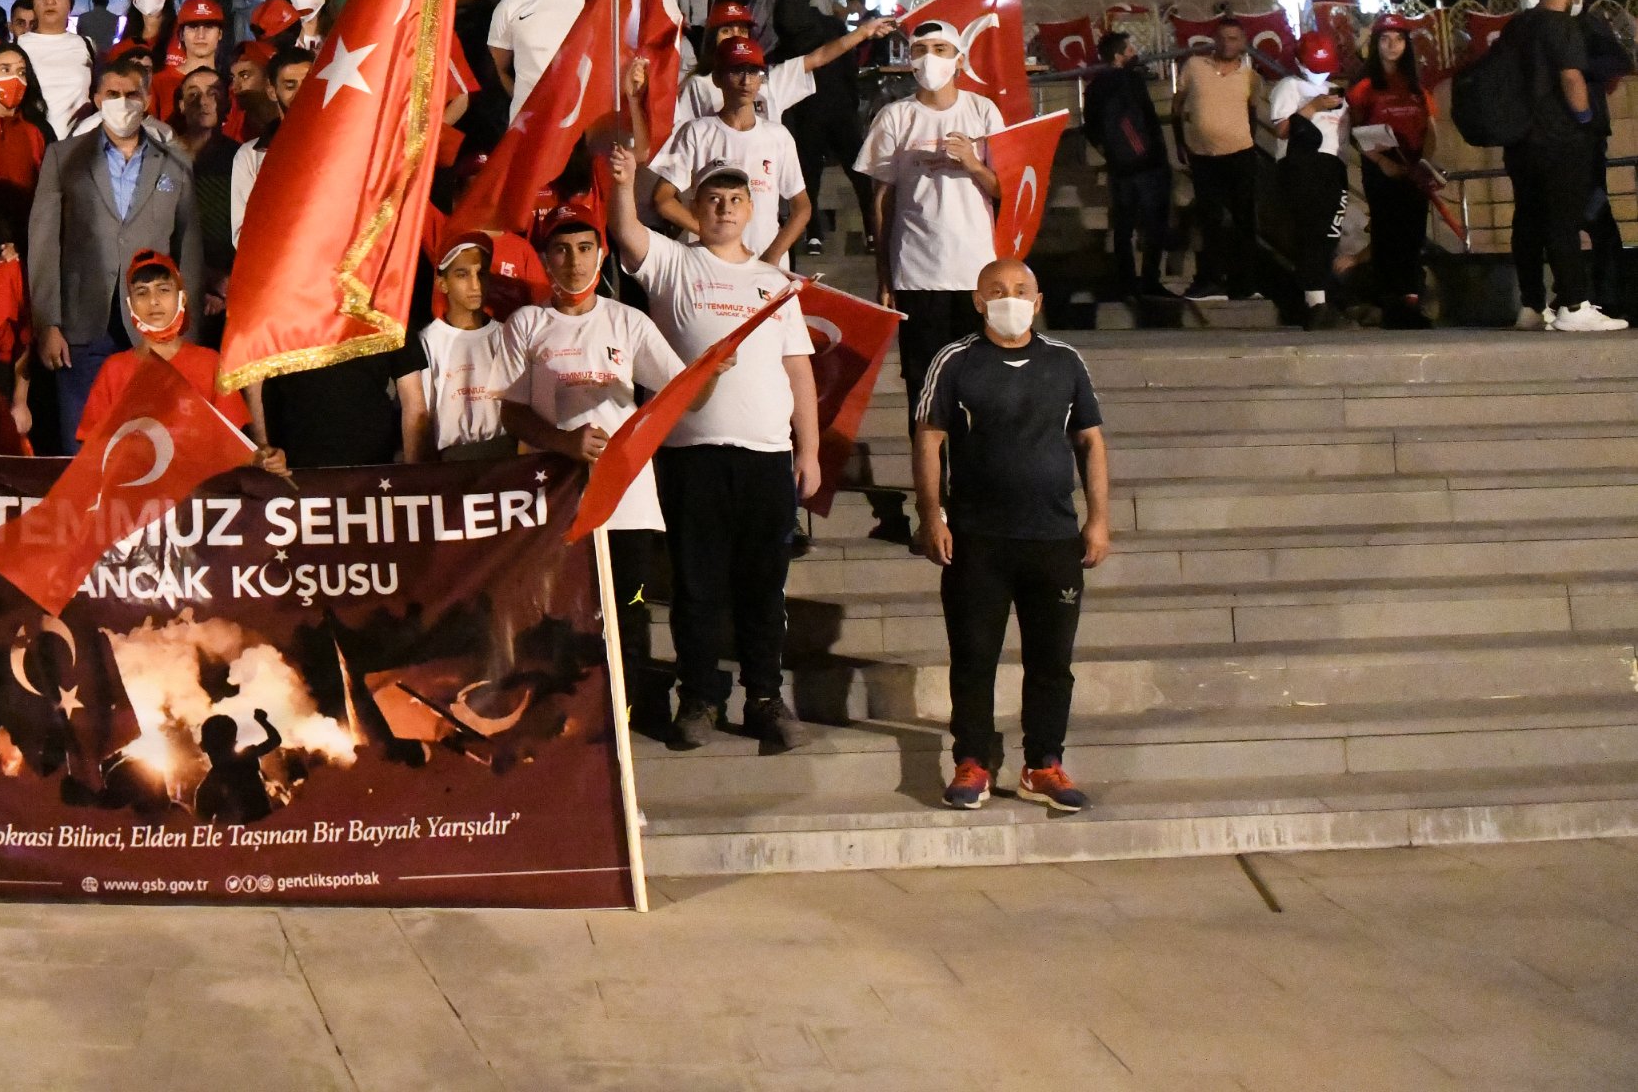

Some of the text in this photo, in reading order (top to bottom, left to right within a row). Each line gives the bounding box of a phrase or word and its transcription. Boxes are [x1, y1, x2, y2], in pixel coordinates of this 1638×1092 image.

[707, 303, 744, 312] TEMMUZ
[558, 371, 593, 381] TEMMUZ
[231, 561, 400, 607] KOŞUSU
[57, 824, 126, 852] Bilinci,
[130, 824, 187, 849] Elden
[192, 824, 224, 848] Ele
[228, 823, 308, 852] Taşınan
[312, 821, 345, 844] Bir
[348, 816, 422, 847] Bayrak
[102, 871, 381, 895] www.gsb.gov.tr gencliksporbak
